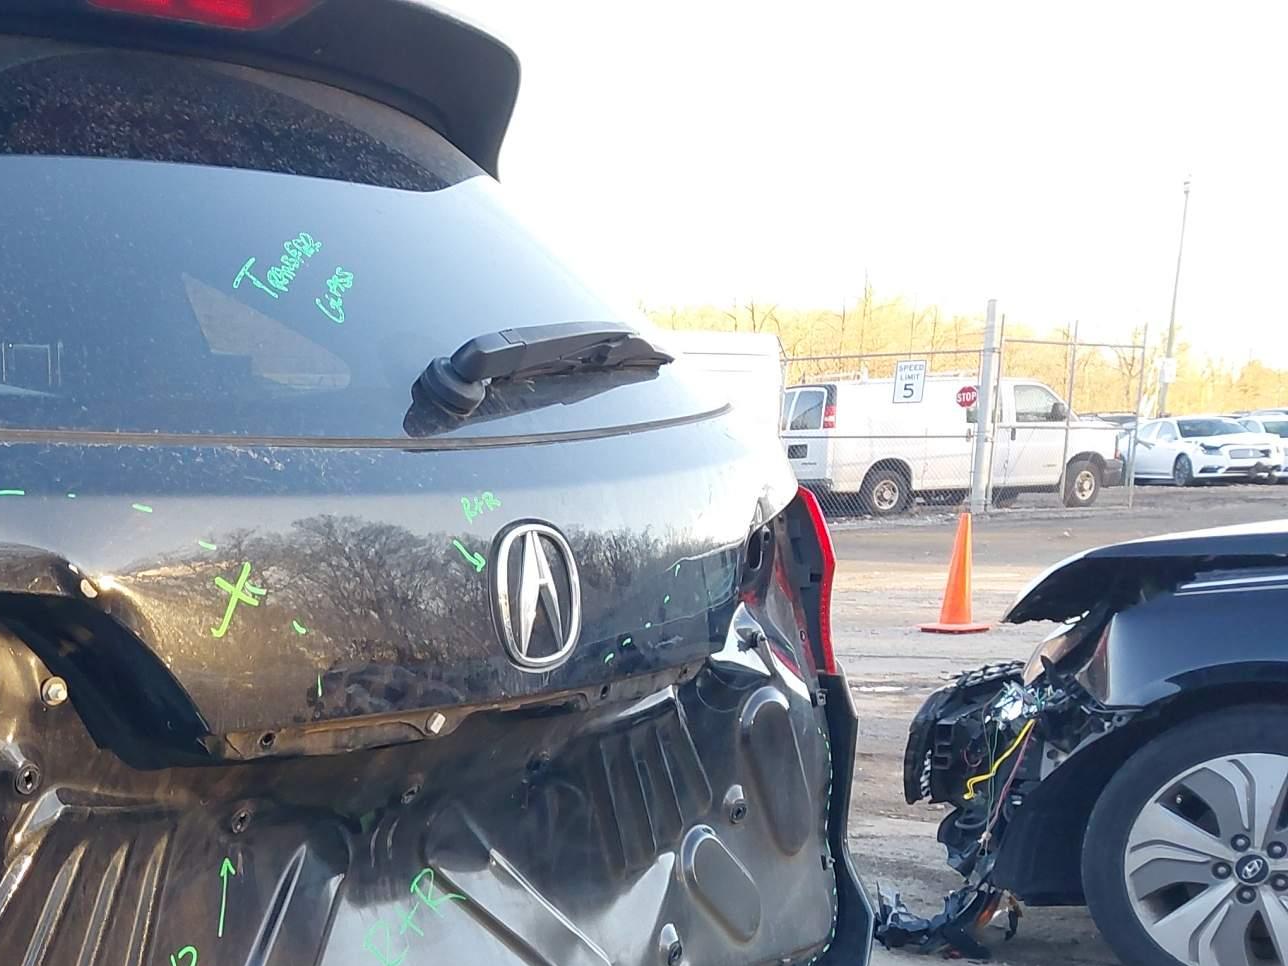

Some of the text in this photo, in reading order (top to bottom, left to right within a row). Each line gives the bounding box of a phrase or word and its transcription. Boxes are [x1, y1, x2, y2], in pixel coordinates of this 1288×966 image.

[899, 364, 924, 372] SPEED
[900, 373, 920, 381] LIMIT
[903, 383, 914, 399] 5
[956, 391, 977, 402] STOP
